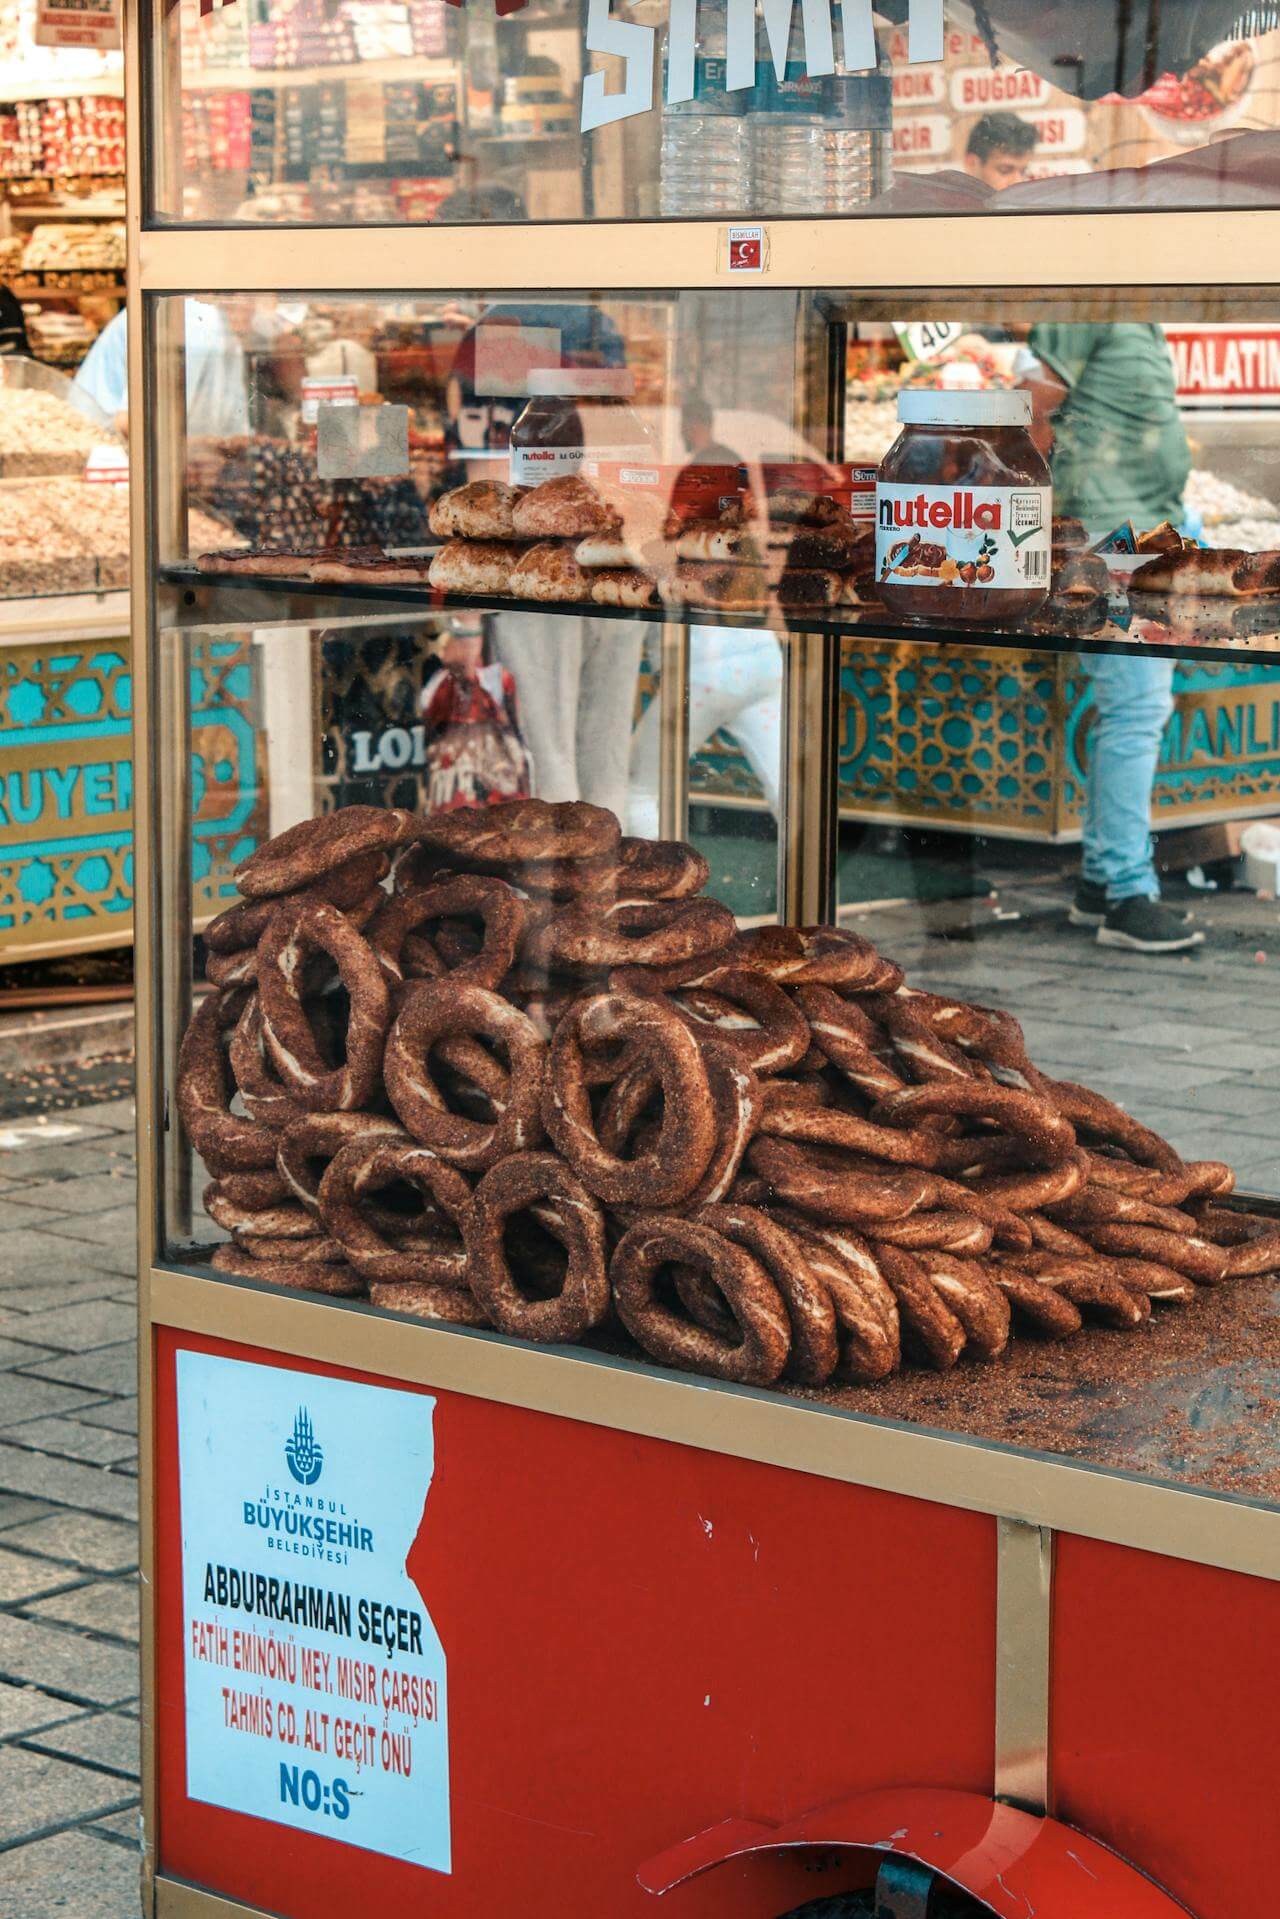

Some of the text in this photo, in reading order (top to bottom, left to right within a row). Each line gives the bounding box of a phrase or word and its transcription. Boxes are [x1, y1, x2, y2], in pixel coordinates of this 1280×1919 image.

[522, 450, 555, 461] nutella
[879, 492, 1002, 530] nutella
[266, 1485, 346, 1516] İSTANBUL
[243, 1498, 374, 1553] BÜYÜKŞEHİR
[268, 1537, 348, 1566] BELEDİYESİ
[204, 1563, 423, 1659] ABDURRAHMAN SEÇER
[192, 1615, 438, 1728] FATİH EMİNÖNÜ MEY. MISIR ÇARŞISI
[222, 1687, 411, 1778] TAHMİS CD. ALT GEÇİT ÖNÜ
